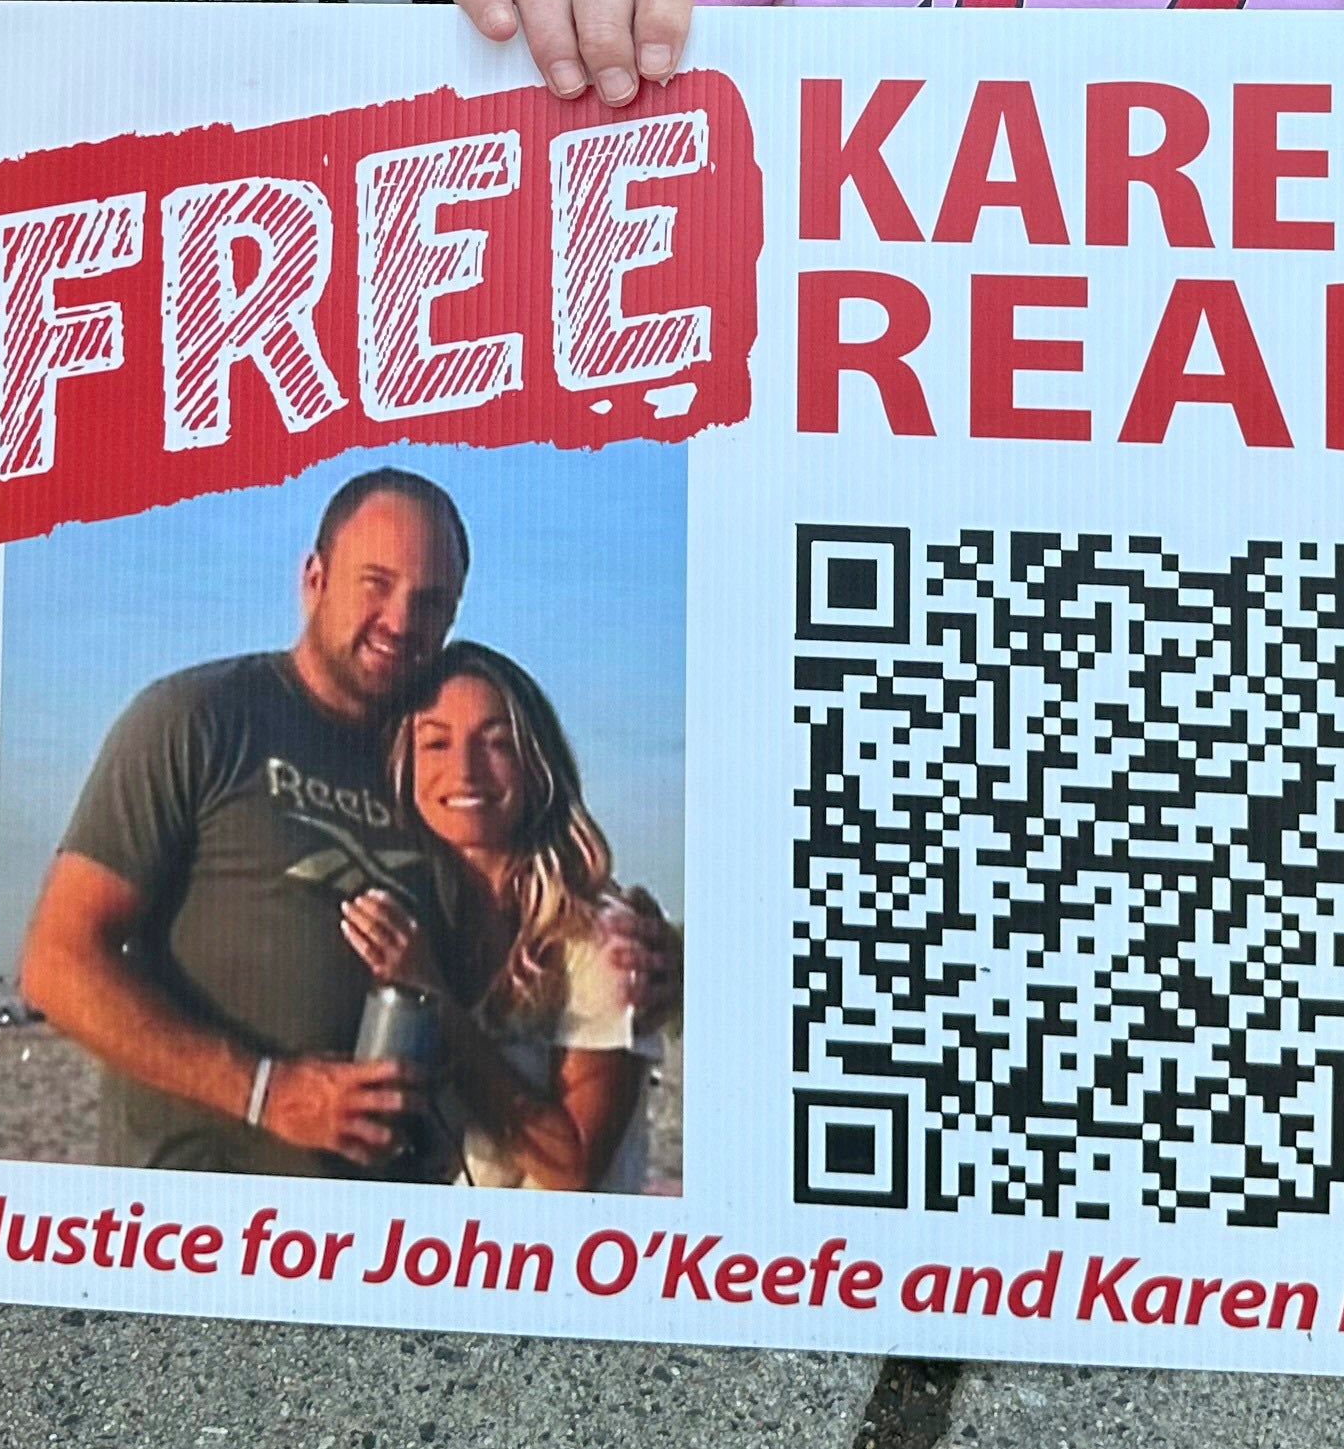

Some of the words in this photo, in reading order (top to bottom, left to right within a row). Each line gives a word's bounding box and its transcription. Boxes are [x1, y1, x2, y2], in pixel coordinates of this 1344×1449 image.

[267, 757, 391, 827] Reeb
[241, 1208, 353, 1280] for
[363, 1219, 553, 1292] John
[576, 1229, 882, 1309] O'Keefe
[901, 1251, 1062, 1318] and
[1077, 1256, 1318, 1330] Karen
